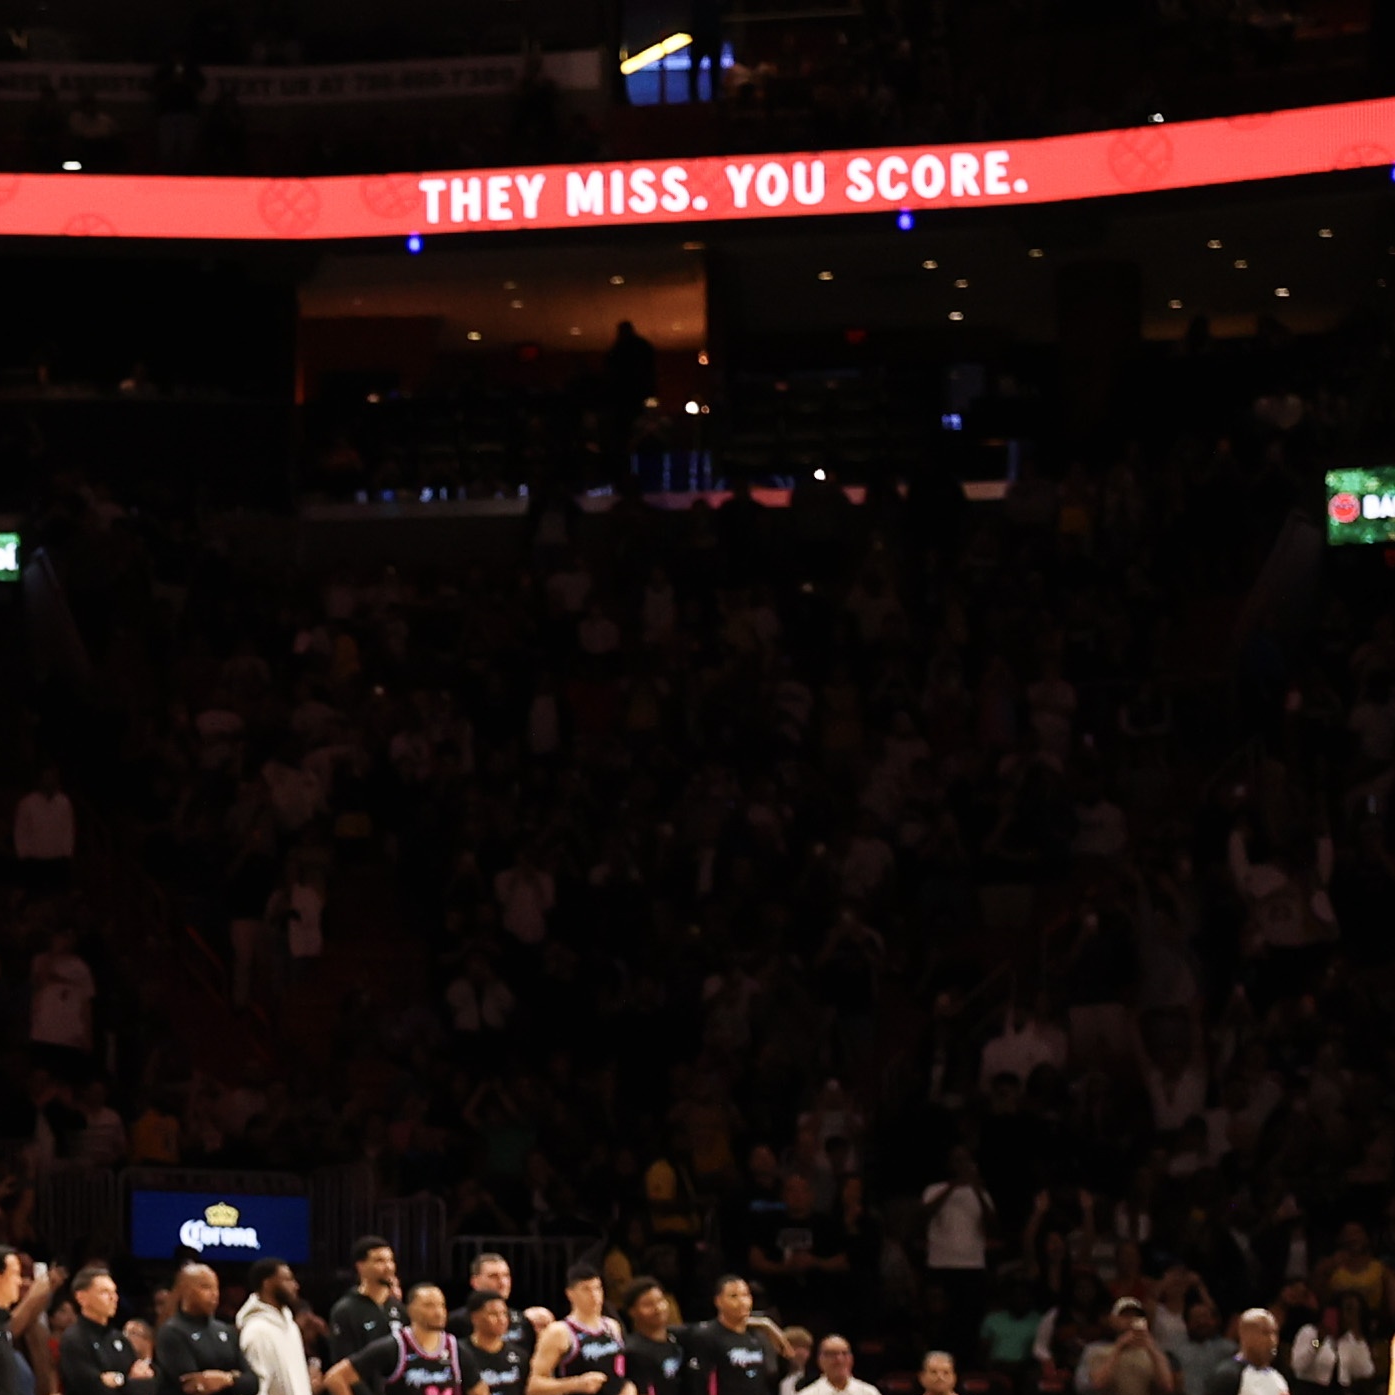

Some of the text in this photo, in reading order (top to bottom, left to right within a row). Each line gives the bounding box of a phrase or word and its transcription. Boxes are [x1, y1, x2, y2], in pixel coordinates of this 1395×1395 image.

[419, 150, 1029, 223] THEY MISS. YOU SCORE.
